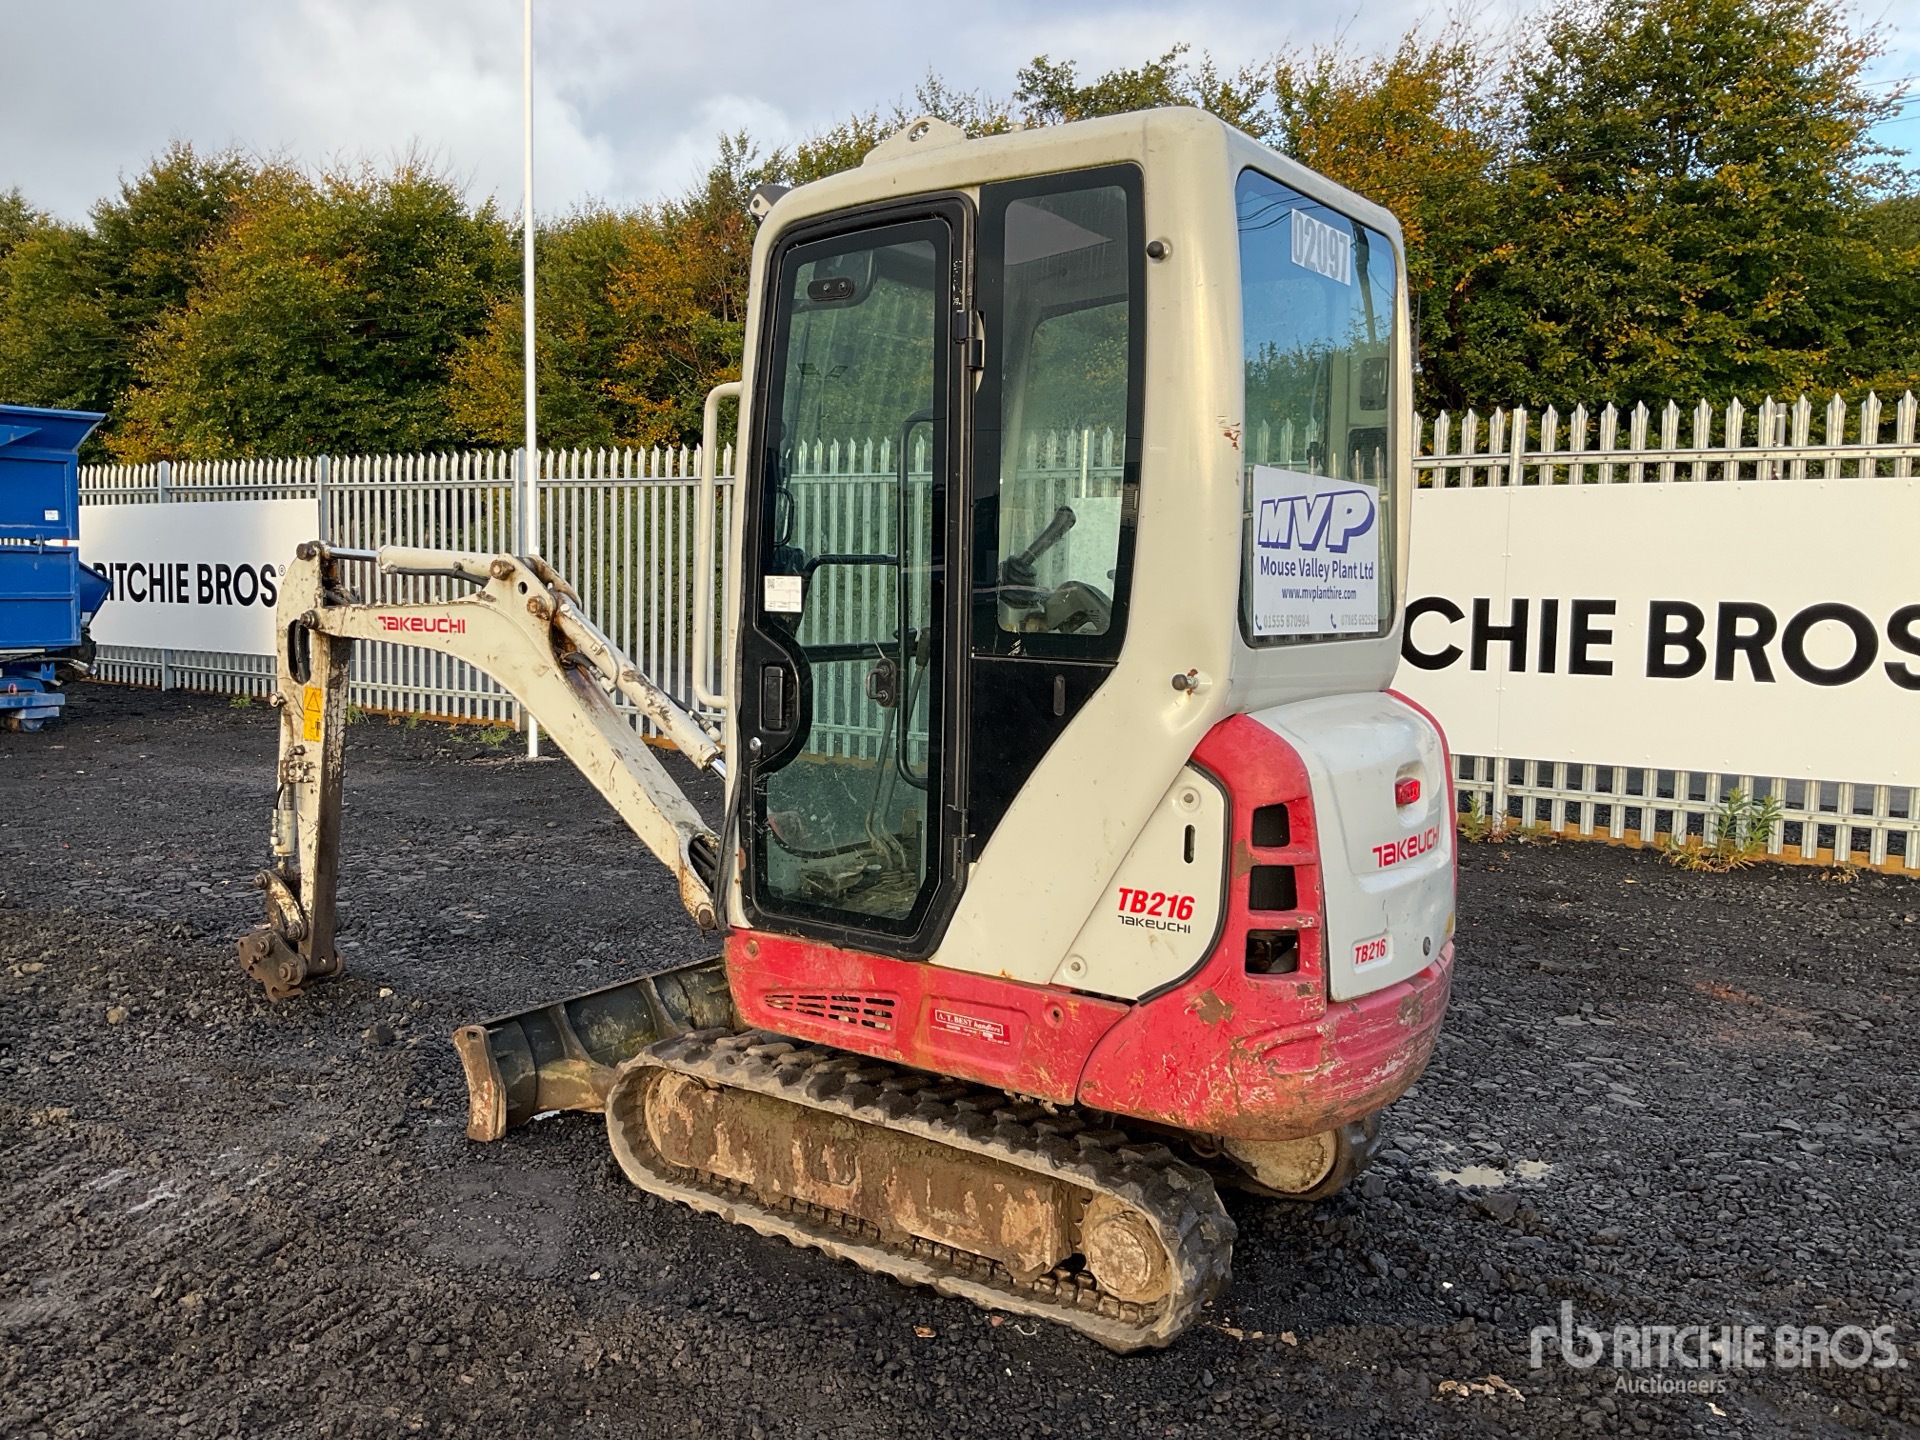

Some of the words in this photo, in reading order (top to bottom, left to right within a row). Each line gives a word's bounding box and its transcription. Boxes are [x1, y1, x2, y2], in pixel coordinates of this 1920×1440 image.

[1293, 211, 1348, 283] 02097
[1258, 489, 1375, 553] MVP
[1260, 555, 1296, 577] Mouse
[1298, 557, 1330, 582] Valley
[1332, 559, 1357, 580] Plant
[1359, 561, 1374, 580] Ltd
[1282, 585, 1357, 602] www.mvplanthire.com
[378, 616, 465, 634] TAKEUCHI
[1263, 614, 1285, 628] 01555
[1118, 887, 1195, 920] TB216
[1118, 915, 1191, 934] TAKEUCHI
[1355, 938, 1386, 965] TB216
[954, 1016, 973, 1026] BEST
